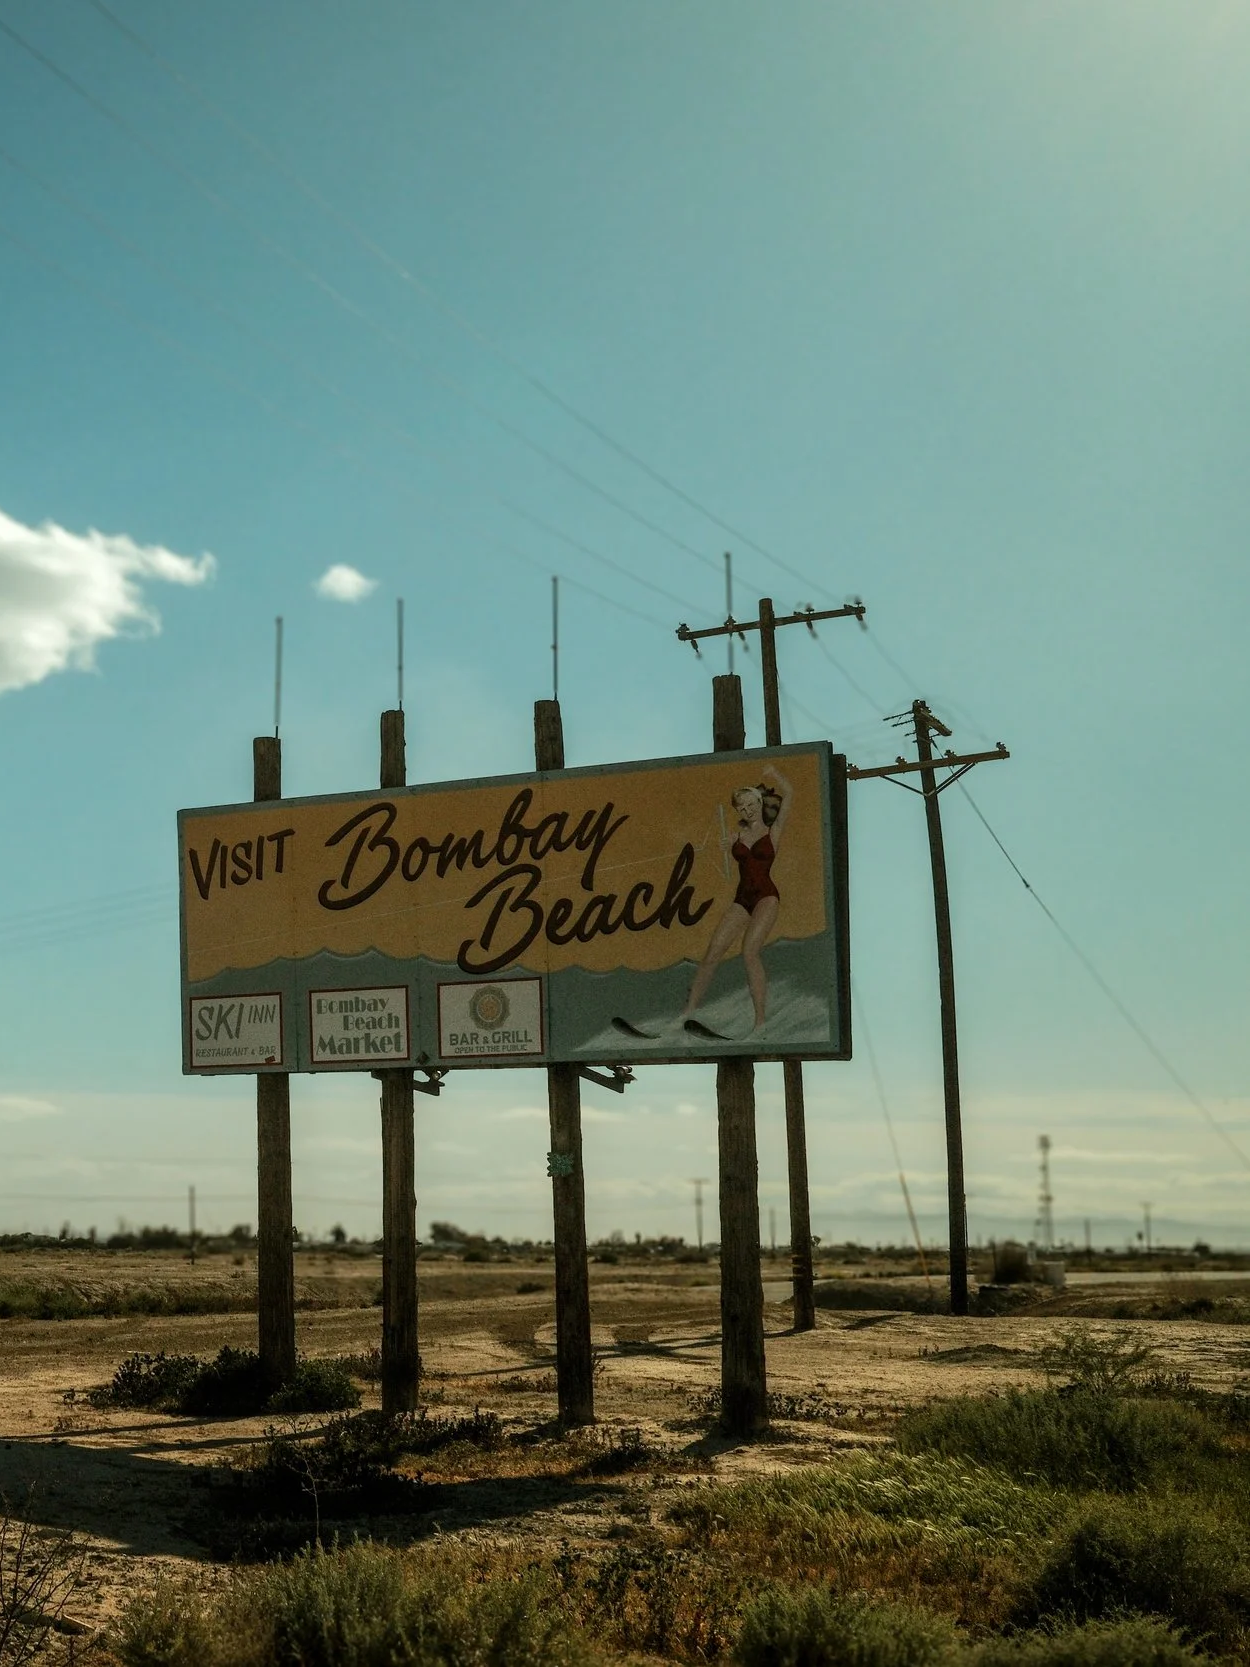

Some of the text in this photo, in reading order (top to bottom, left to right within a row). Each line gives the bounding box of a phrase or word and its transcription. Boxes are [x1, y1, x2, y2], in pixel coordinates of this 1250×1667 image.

[189, 788, 630, 910] VISIT Bombay
[457, 842, 713, 974] Beach
[316, 996, 389, 1015] Bombay
[195, 1002, 276, 1041] SKI INN
[342, 1012, 400, 1031] Beach
[315, 1031, 404, 1056] Market
[449, 1029, 533, 1046] BAR & GRILL
[195, 1047, 249, 1058] RESTAURANT
[258, 1045, 276, 1056] BAR
[454, 1046, 474, 1054] OPEN
[486, 1045, 500, 1053] THE
[502, 1044, 528, 1052] PUBLIC
